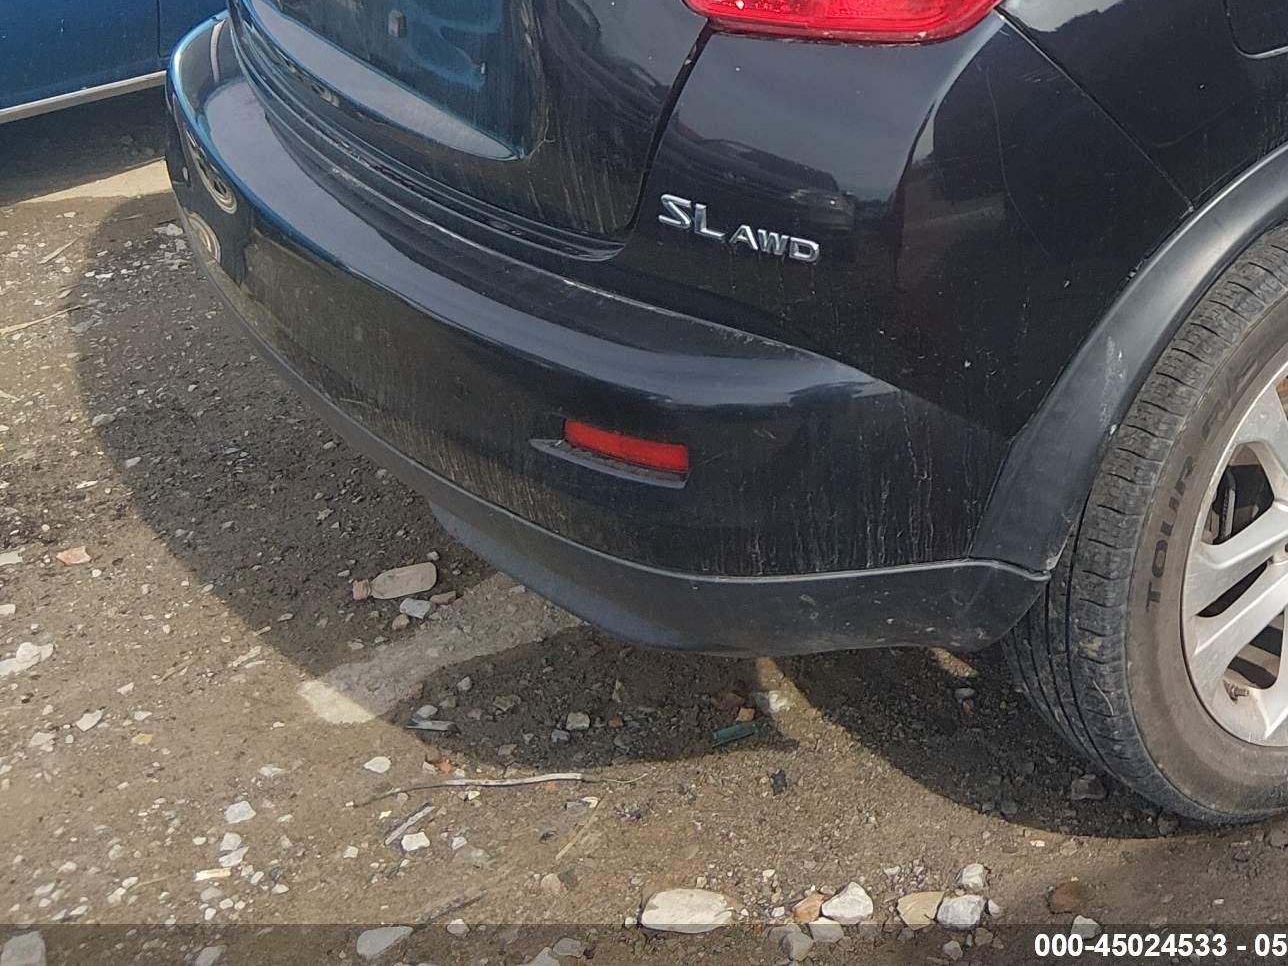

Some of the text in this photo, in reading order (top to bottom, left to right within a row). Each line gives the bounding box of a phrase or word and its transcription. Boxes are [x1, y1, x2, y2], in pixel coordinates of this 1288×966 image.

[658, 193, 820, 263] SL AWD
[1145, 455, 1194, 614] TOUR
